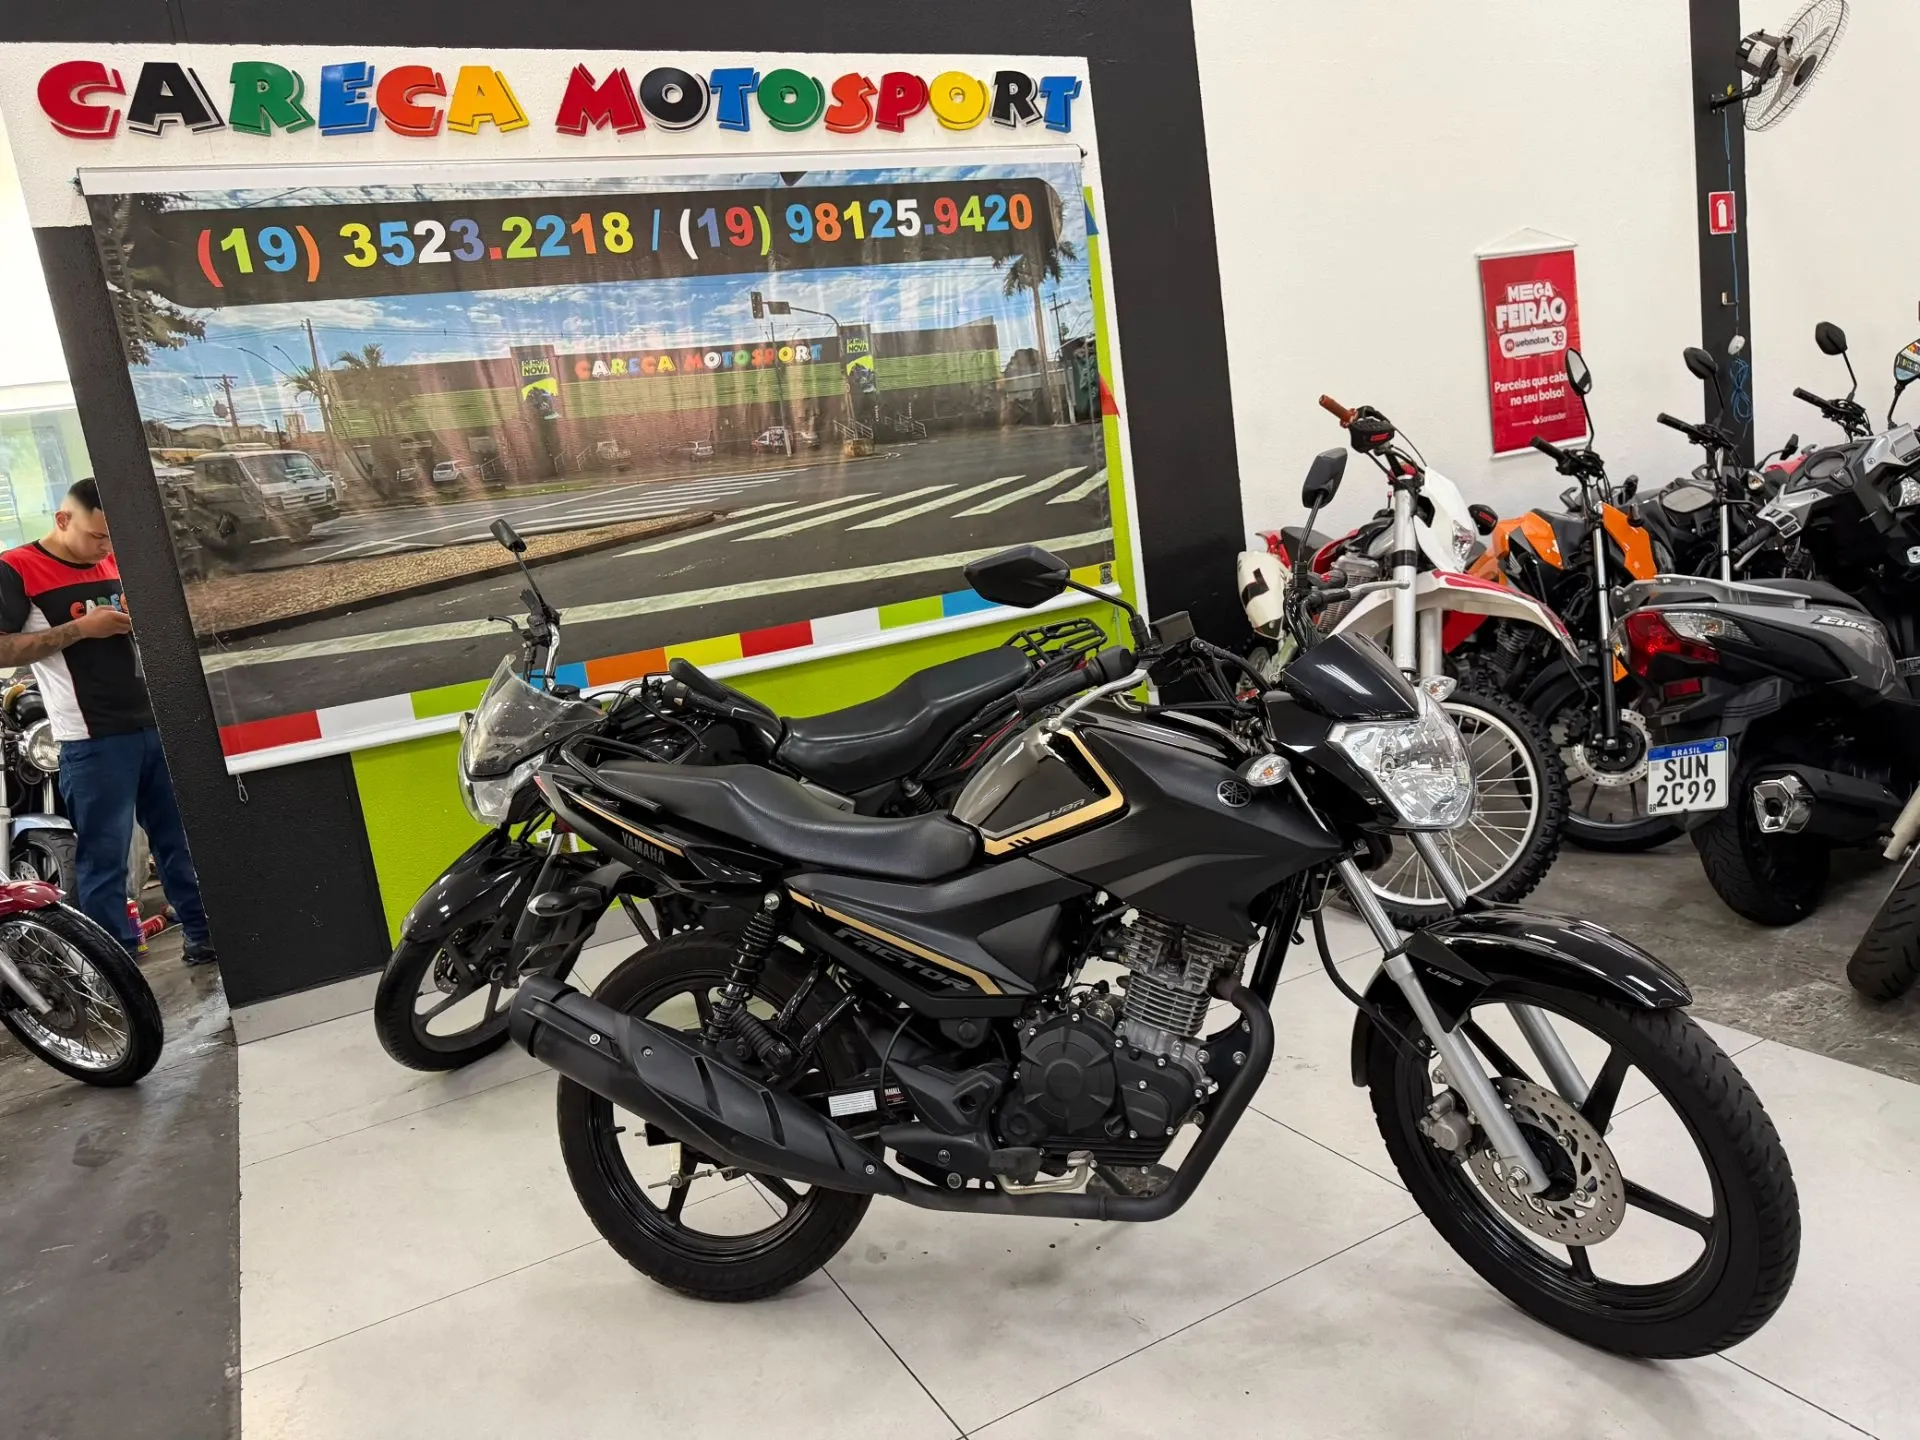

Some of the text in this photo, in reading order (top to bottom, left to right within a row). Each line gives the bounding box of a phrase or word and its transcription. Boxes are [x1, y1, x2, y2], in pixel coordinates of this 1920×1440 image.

[37, 60, 1083, 140] CARECA MOTOSPORT
[197, 193, 1033, 287] (19) 3523.2218 / (19) 98125.9420
[1507, 281, 1554, 303] MEGA
[1495, 296, 1567, 330] FEIRÃO
[523, 365, 549, 376] NOVA
[574, 344, 823, 380] CARECA MOTOSPORT
[1494, 378, 1531, 393] Parcelas
[1532, 376, 1548, 389] que
[1510, 385, 1565, 407] no seu bolso!
[1671, 746, 1701, 757] BRASIL
[1663, 754, 1709, 782] SUN
[1656, 778, 1717, 808] 2C99
[621, 831, 666, 866] YAMAHA
[833, 927, 972, 992] FACTOR
